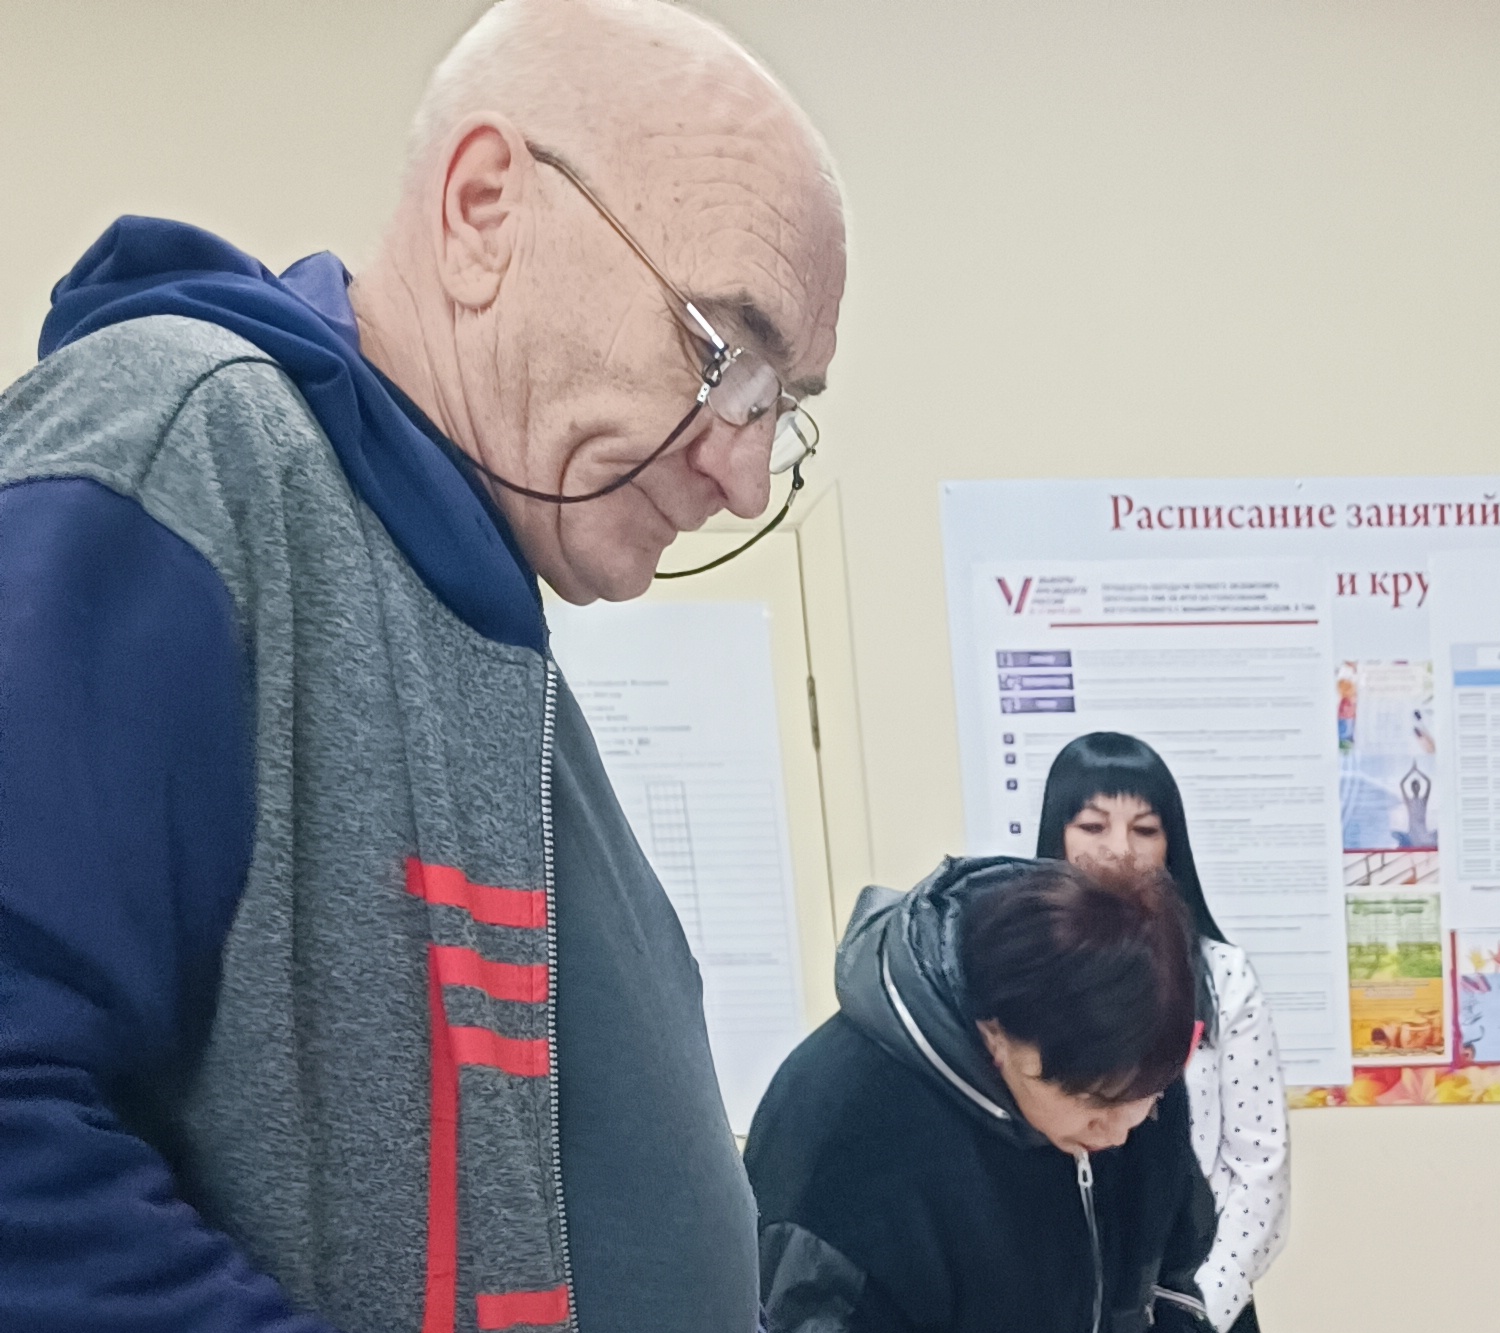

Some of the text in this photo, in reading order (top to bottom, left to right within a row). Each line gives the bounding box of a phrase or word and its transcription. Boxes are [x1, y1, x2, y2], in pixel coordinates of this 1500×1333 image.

[1110, 493, 1500, 531] Расписание занятий
[1337, 572, 1358, 595] и
